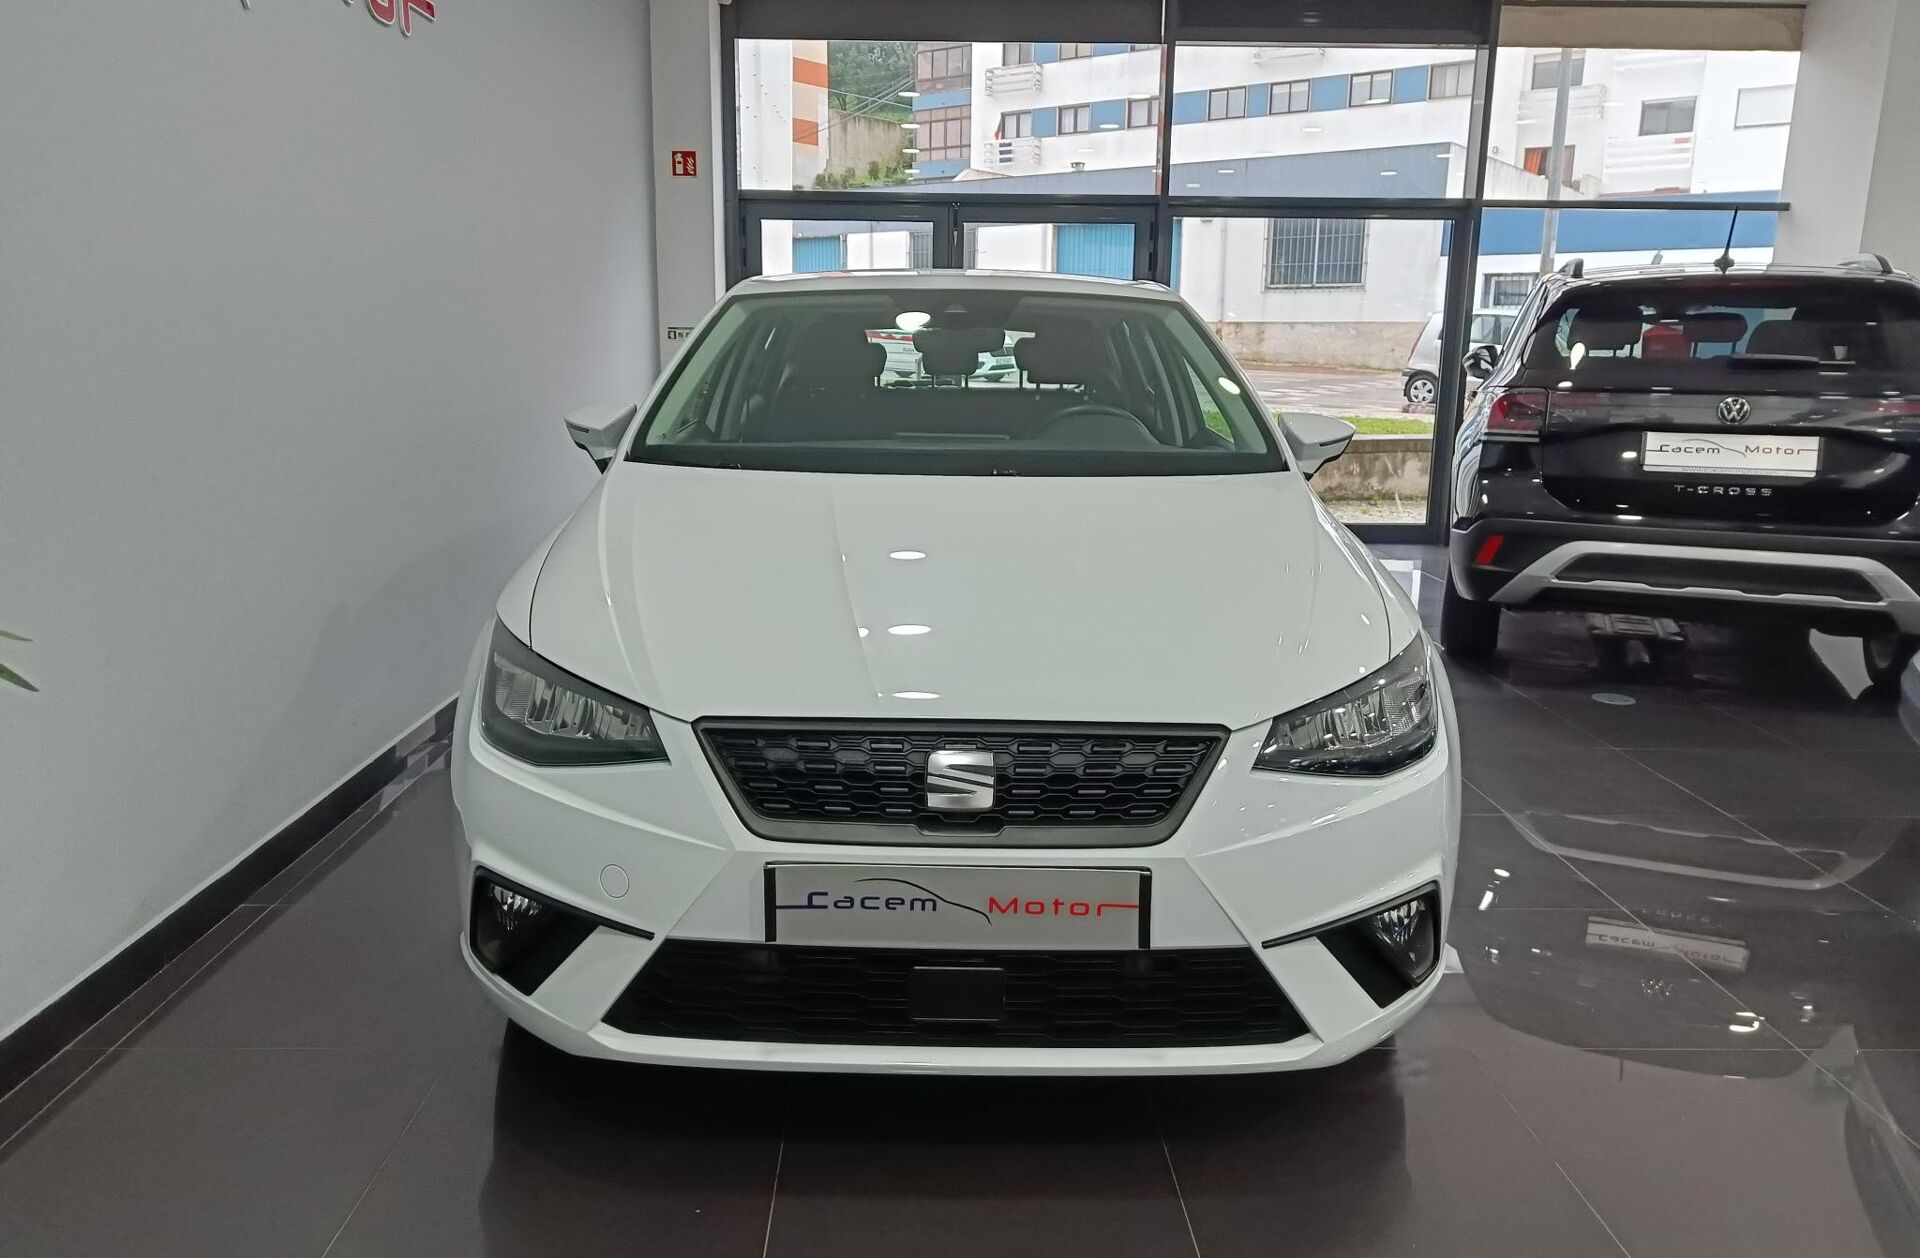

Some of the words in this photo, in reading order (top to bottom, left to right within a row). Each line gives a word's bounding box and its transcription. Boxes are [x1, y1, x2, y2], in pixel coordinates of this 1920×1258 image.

[1659, 444, 1720, 455] Cacem
[1745, 444, 1819, 456] Motor
[1674, 484, 1773, 497] T-CROSS
[807, 891, 937, 912] Cacem
[988, 896, 1140, 918] Motor
